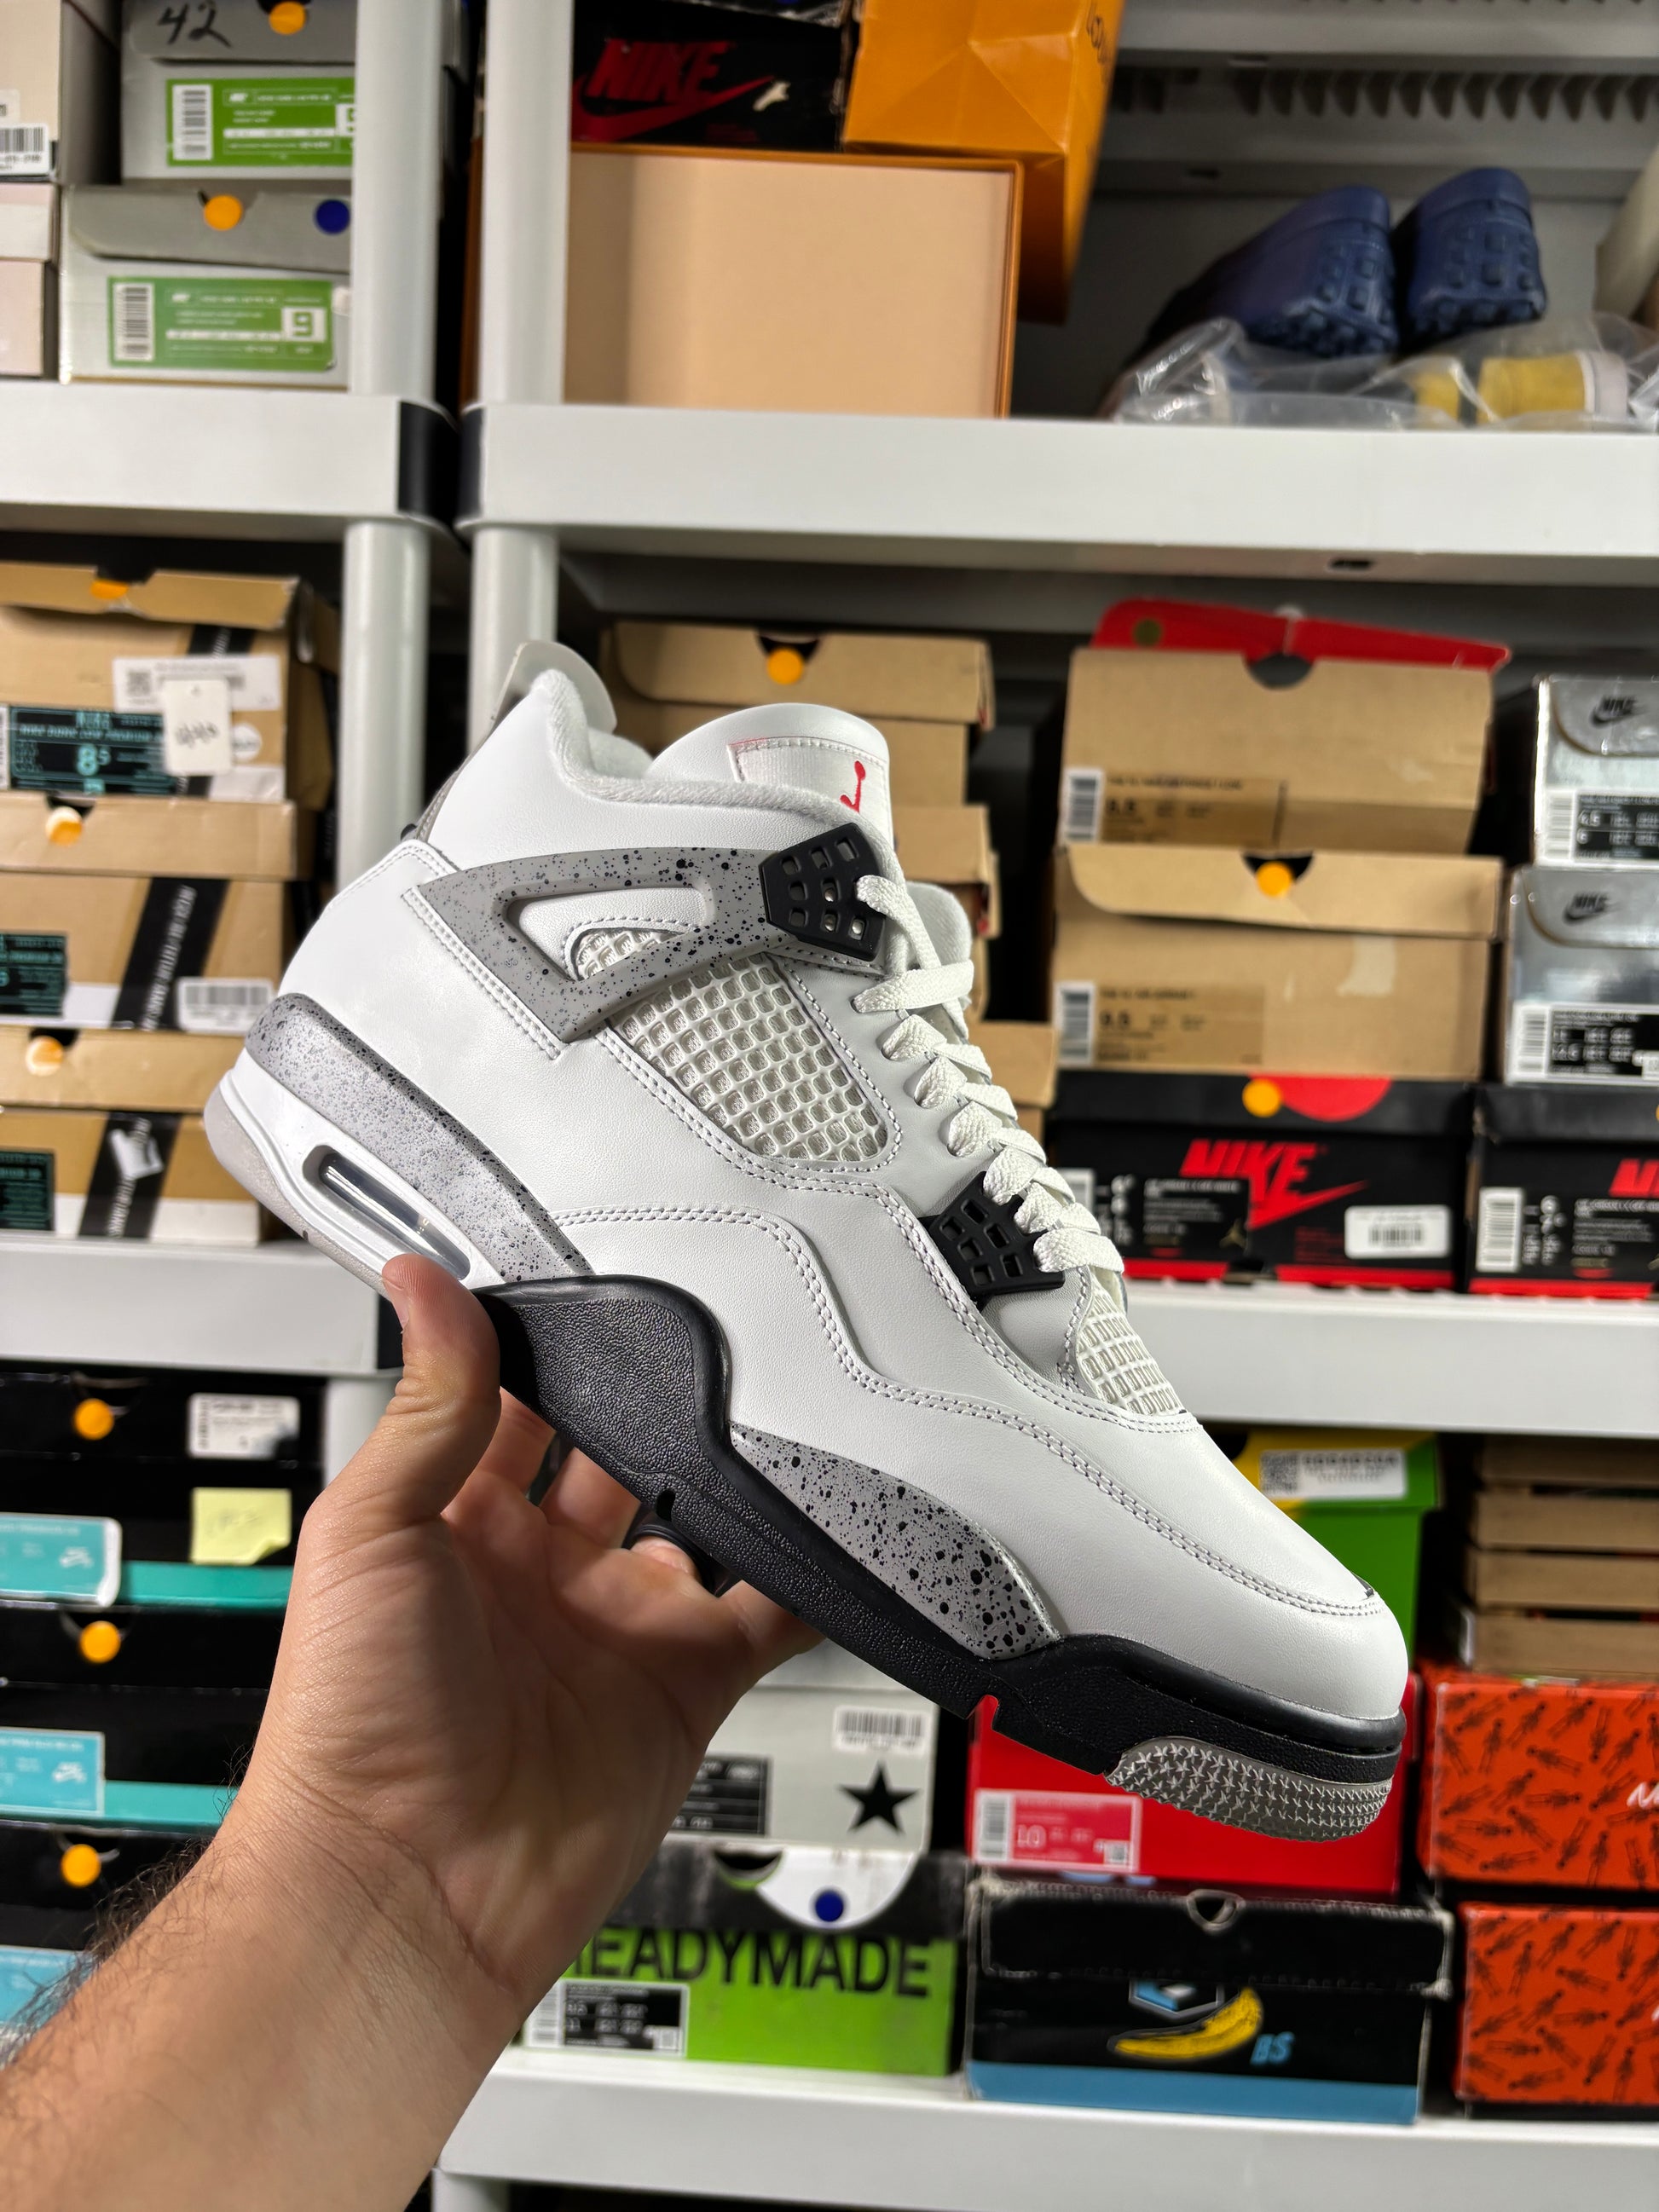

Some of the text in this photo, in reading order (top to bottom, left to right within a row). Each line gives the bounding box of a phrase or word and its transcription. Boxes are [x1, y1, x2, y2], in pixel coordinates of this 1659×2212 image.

[157, 3, 232, 49] 42
[586, 38, 729, 102] NIKE
[1179, 1139, 1317, 1201] NIKE
[574, 1928, 930, 1998] EADYMADE
